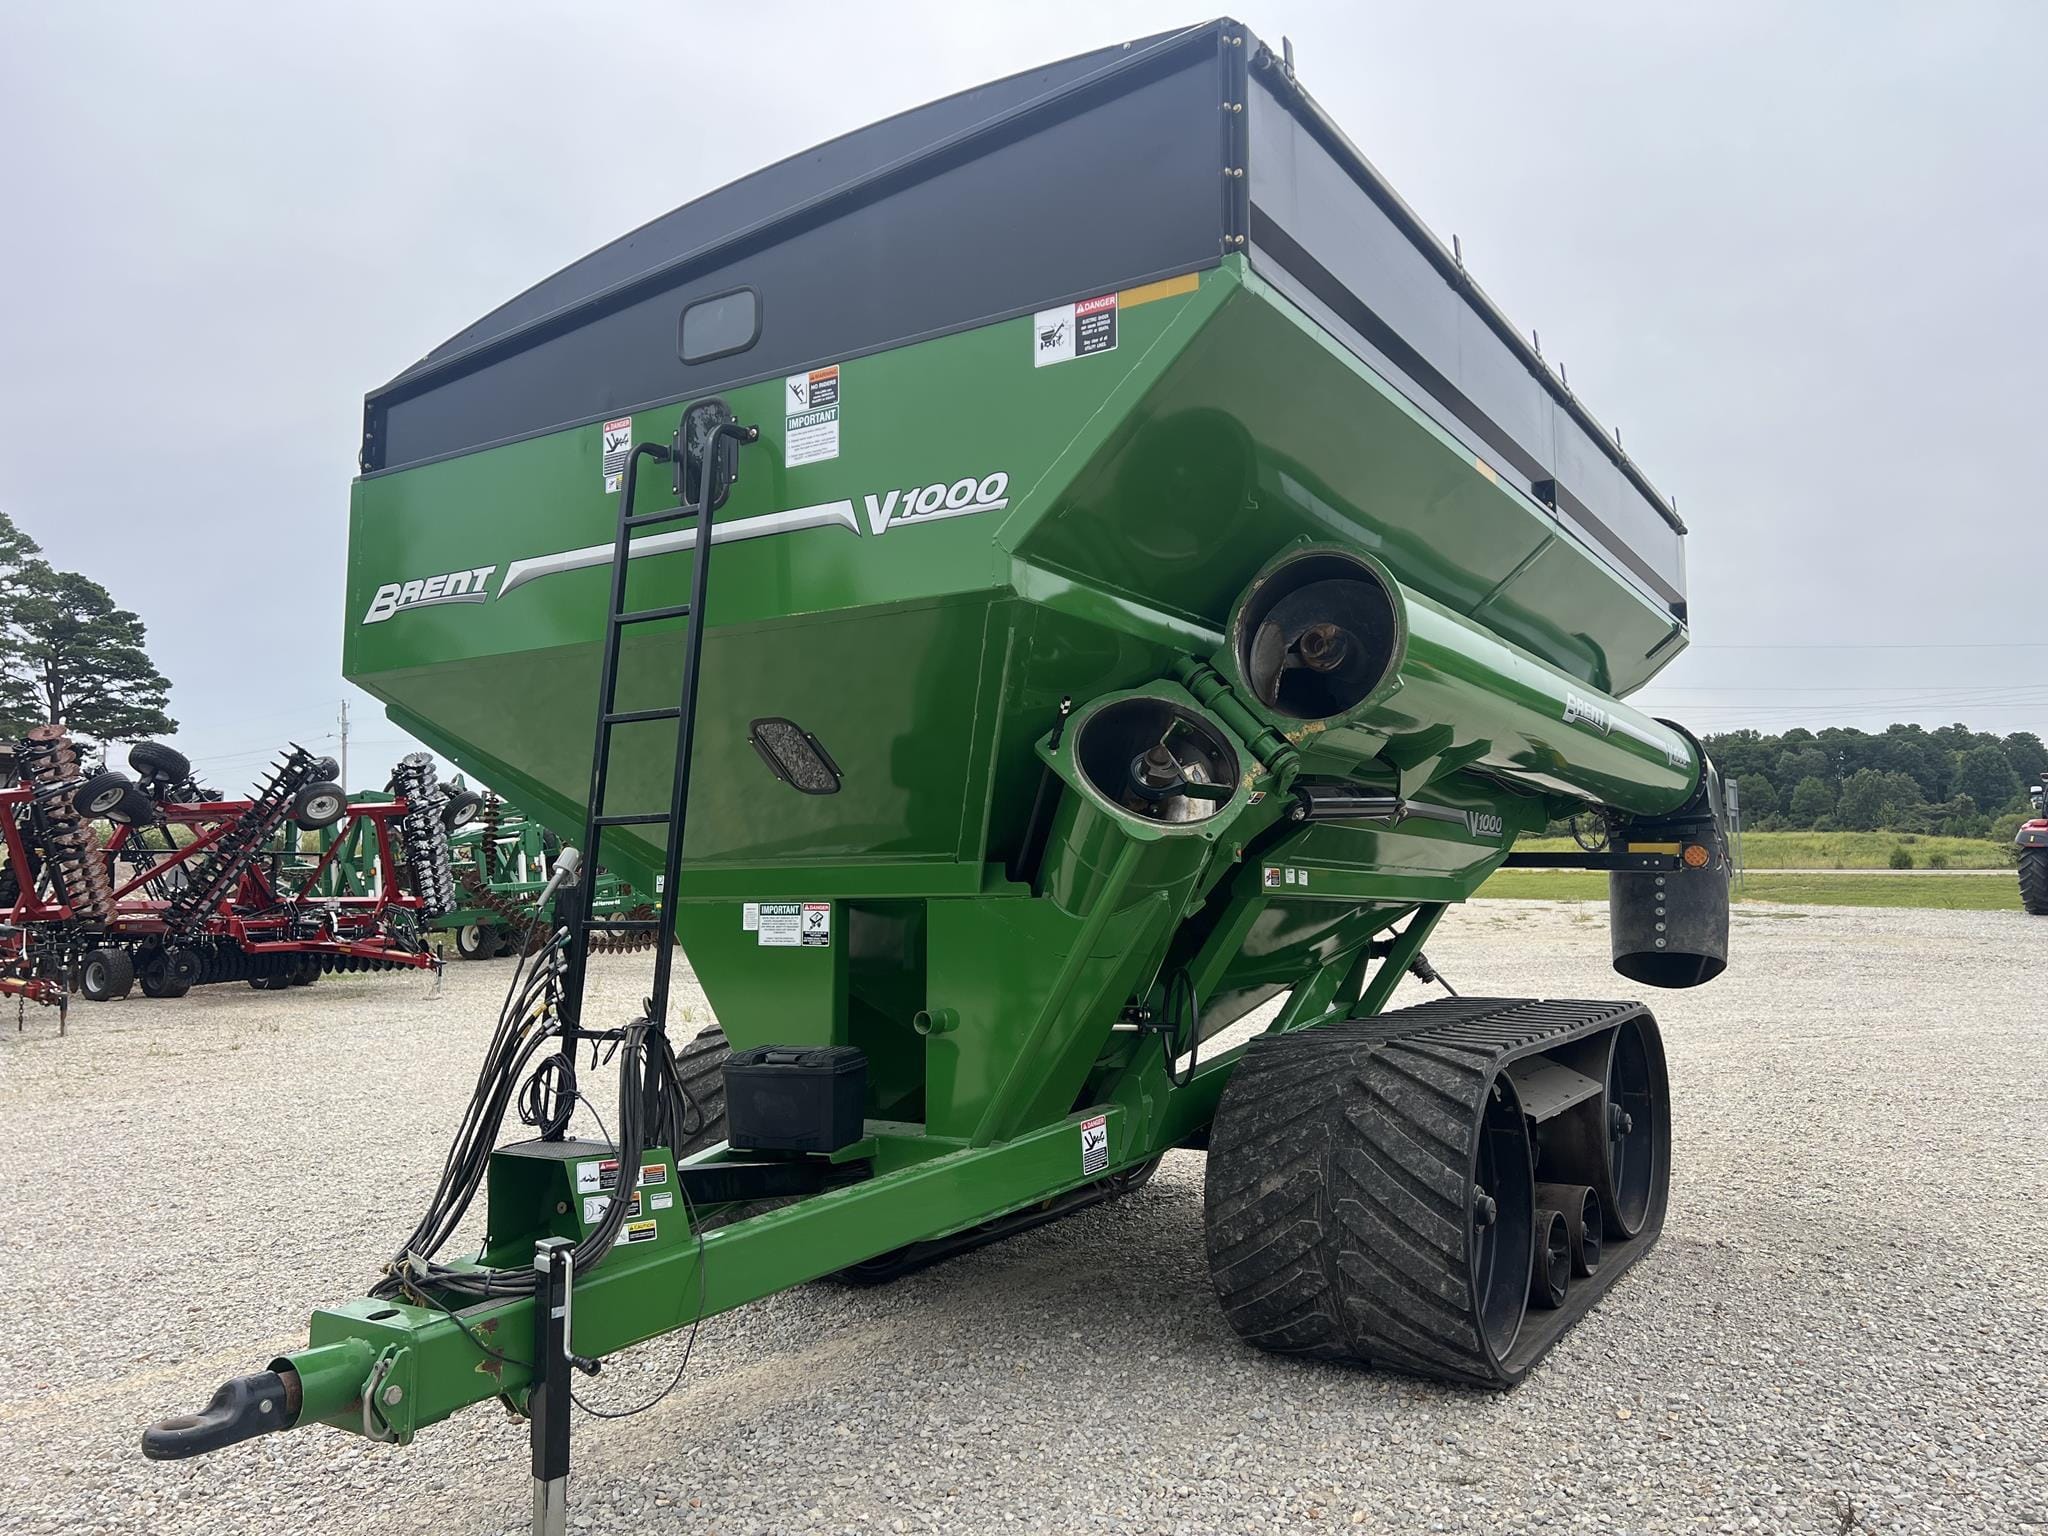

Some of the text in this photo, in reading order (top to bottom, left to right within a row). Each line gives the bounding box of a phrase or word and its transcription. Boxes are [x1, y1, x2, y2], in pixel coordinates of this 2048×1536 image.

[1084, 297, 1116, 311] DANGER
[789, 409, 836, 429] IMPORTANT
[864, 471, 1009, 536] V1000
[362, 564, 497, 625] BRENT
[1470, 811, 1502, 837] V1000
[761, 905, 799, 915] IMPORTANT
